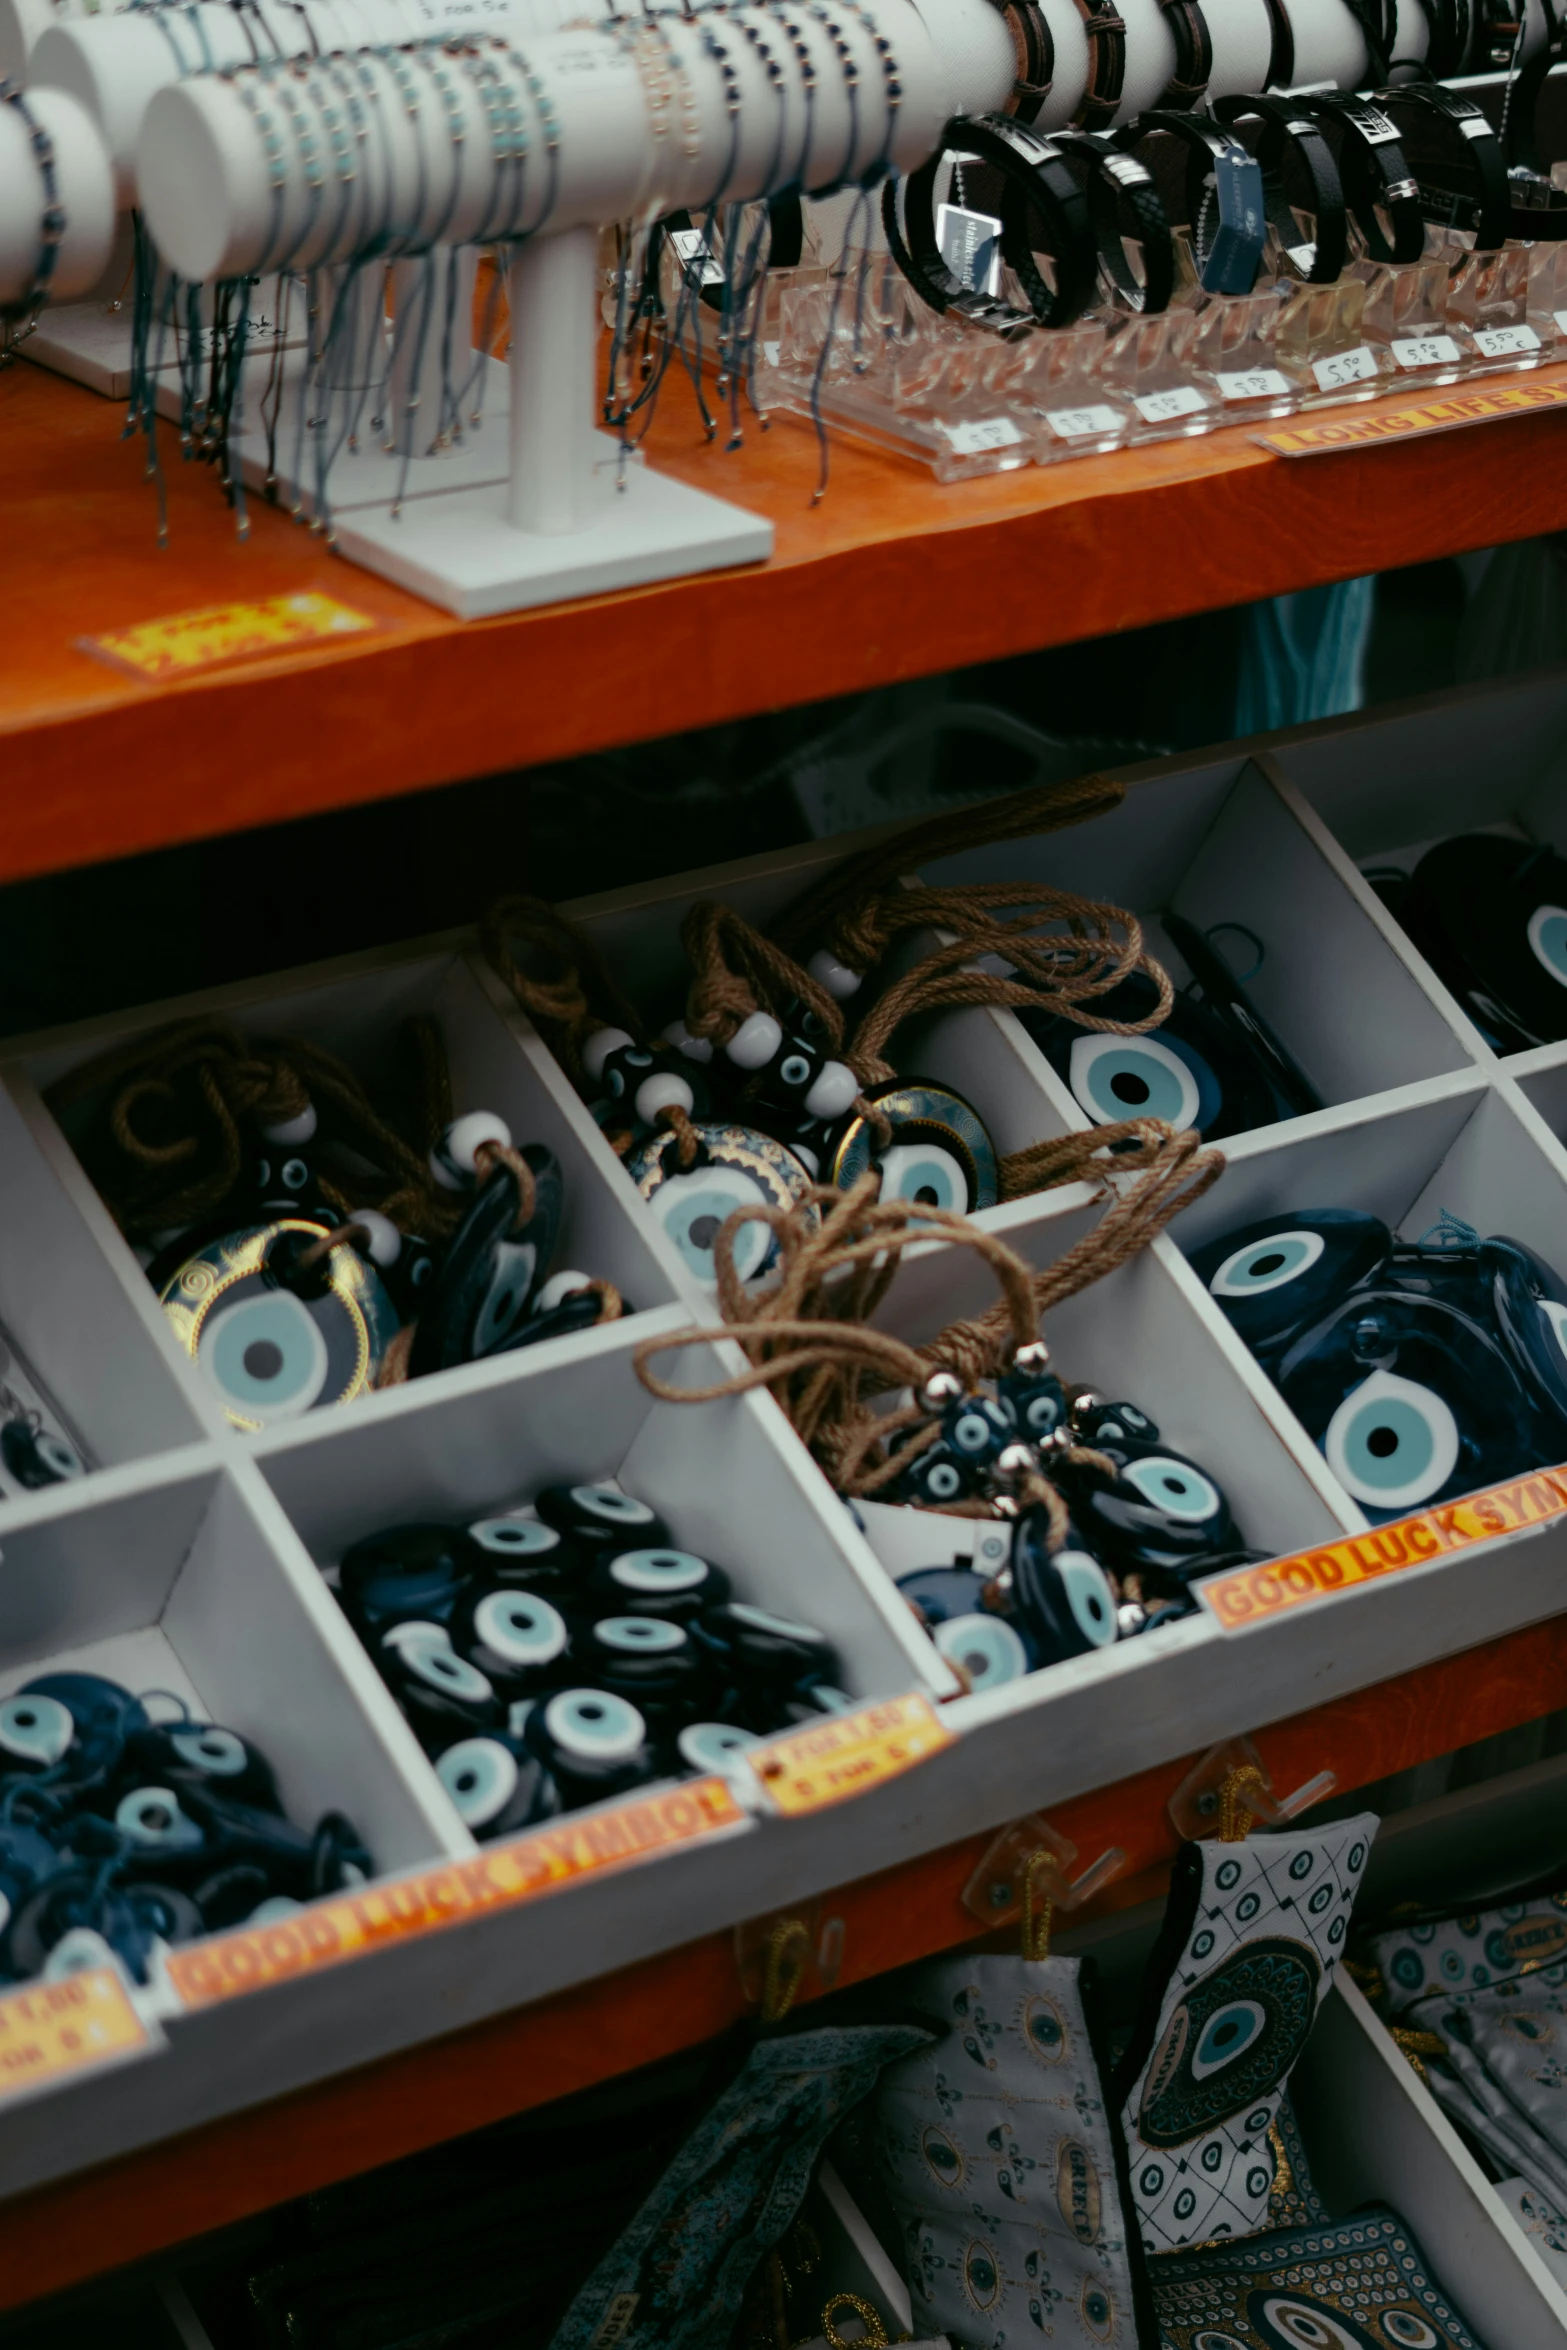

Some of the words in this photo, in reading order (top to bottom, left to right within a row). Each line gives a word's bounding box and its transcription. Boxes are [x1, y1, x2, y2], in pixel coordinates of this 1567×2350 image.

[964, 220, 979, 265] stainless
[1286, 415, 1415, 448] LONG
[1417, 393, 1521, 424] LIFE
[1217, 1552, 1346, 1618] GOOD
[1346, 1510, 1473, 1575] LUCK
[178, 1911, 343, 1996] GOOD
[348, 1865, 502, 1940] LUCK
[511, 1793, 729, 1882] SYMBOL
[1069, 2149, 1094, 2237] GREECE
[596, 2299, 632, 2350] ODES
